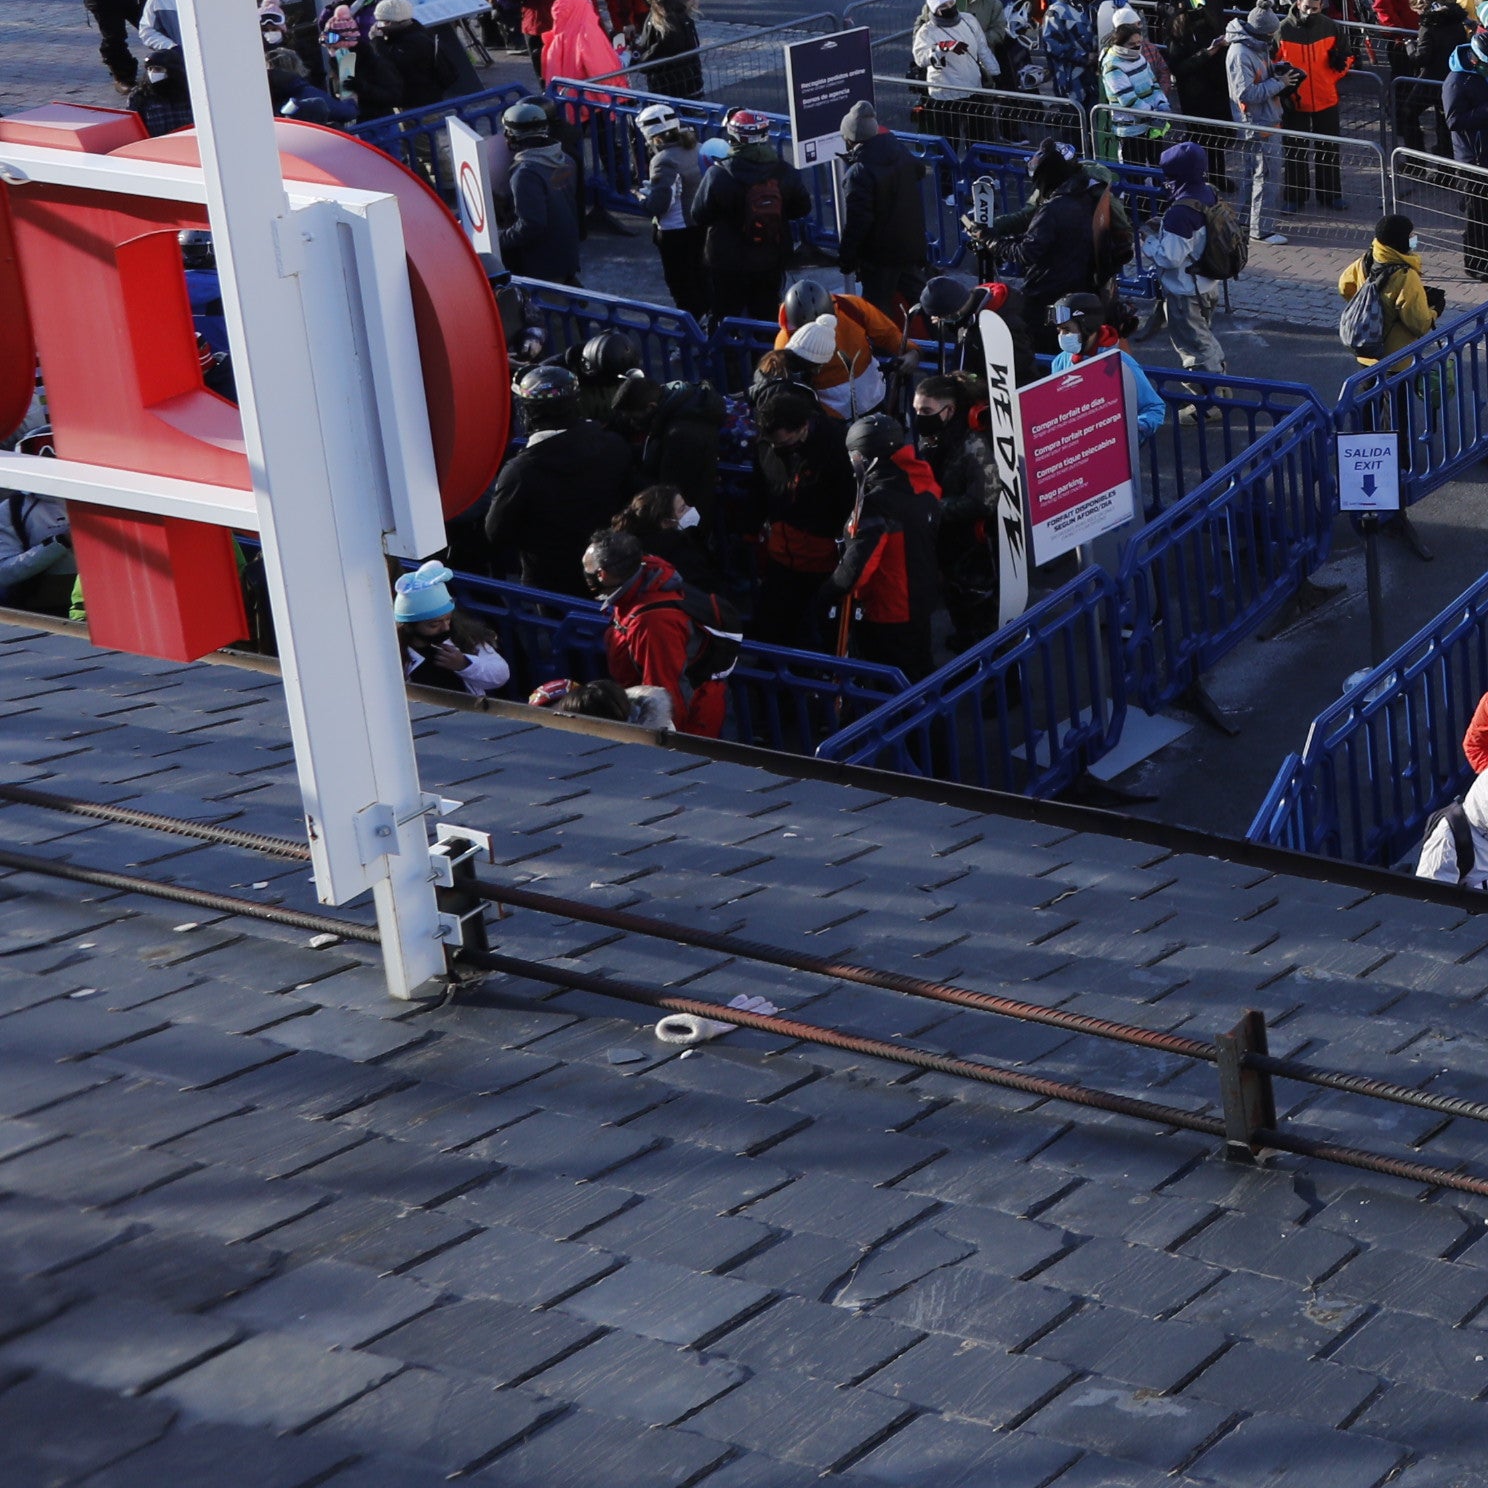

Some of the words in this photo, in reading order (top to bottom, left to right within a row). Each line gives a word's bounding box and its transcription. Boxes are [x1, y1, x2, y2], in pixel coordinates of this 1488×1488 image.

[800, 78, 827, 90] Recogida
[827, 72, 849, 85] pedidos
[849, 68, 866, 78] online
[802, 94, 821, 105] Bonos
[821, 92, 829, 100] de
[829, 88, 850, 100] agencia
[979, 199, 989, 222] ATO
[1031, 417, 1058, 434] Compra
[1059, 407, 1081, 423] forfait
[1081, 402, 1090, 411] de
[1034, 440, 1061, 457] Compra
[1061, 430, 1083, 444] forfait
[1083, 424, 1095, 435] por
[1095, 413, 1121, 430] recarga
[1036, 462, 1063, 479] Compra
[1063, 453, 1082, 466] tique
[1082, 437, 1116, 458] telecabina
[1344, 447, 1391, 458] SALIDA
[1354, 460, 1383, 471] EXIT
[1039, 489, 1057, 503] Pago
[1057, 477, 1083, 496] parking
[1047, 511, 1074, 527] FORFAIT
[1075, 490, 1117, 515] DISPONIBLES
